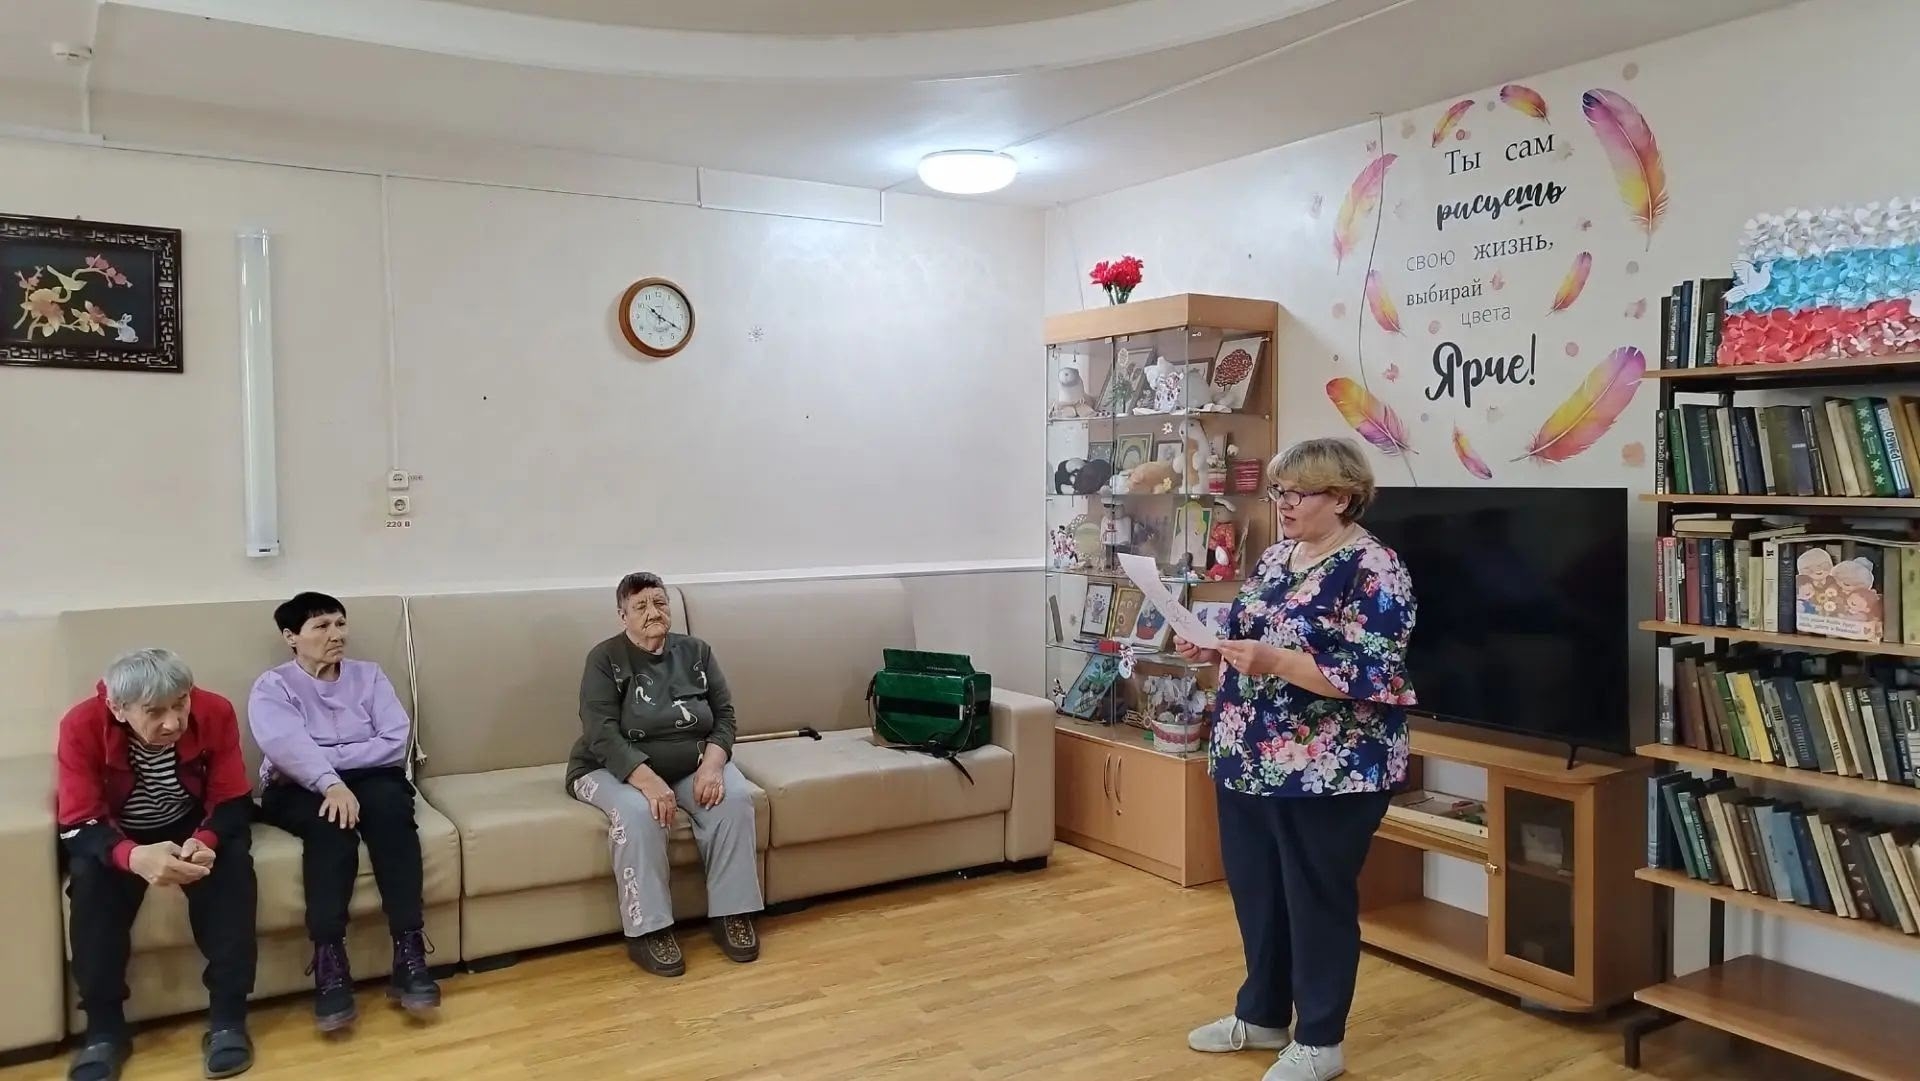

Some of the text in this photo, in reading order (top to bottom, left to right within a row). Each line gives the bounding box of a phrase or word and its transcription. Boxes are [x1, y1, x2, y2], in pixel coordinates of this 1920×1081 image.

[1445, 132, 1556, 176] Ты сам
[1406, 234, 1554, 273] свою жизнь,
[1406, 278, 1483, 306] выбирай
[1460, 305, 1512, 329] цвета
[1425, 333, 1537, 409] Ярче!
[1885, 430, 1901, 460] РЭМБО
[386, 520, 402, 528] 220
